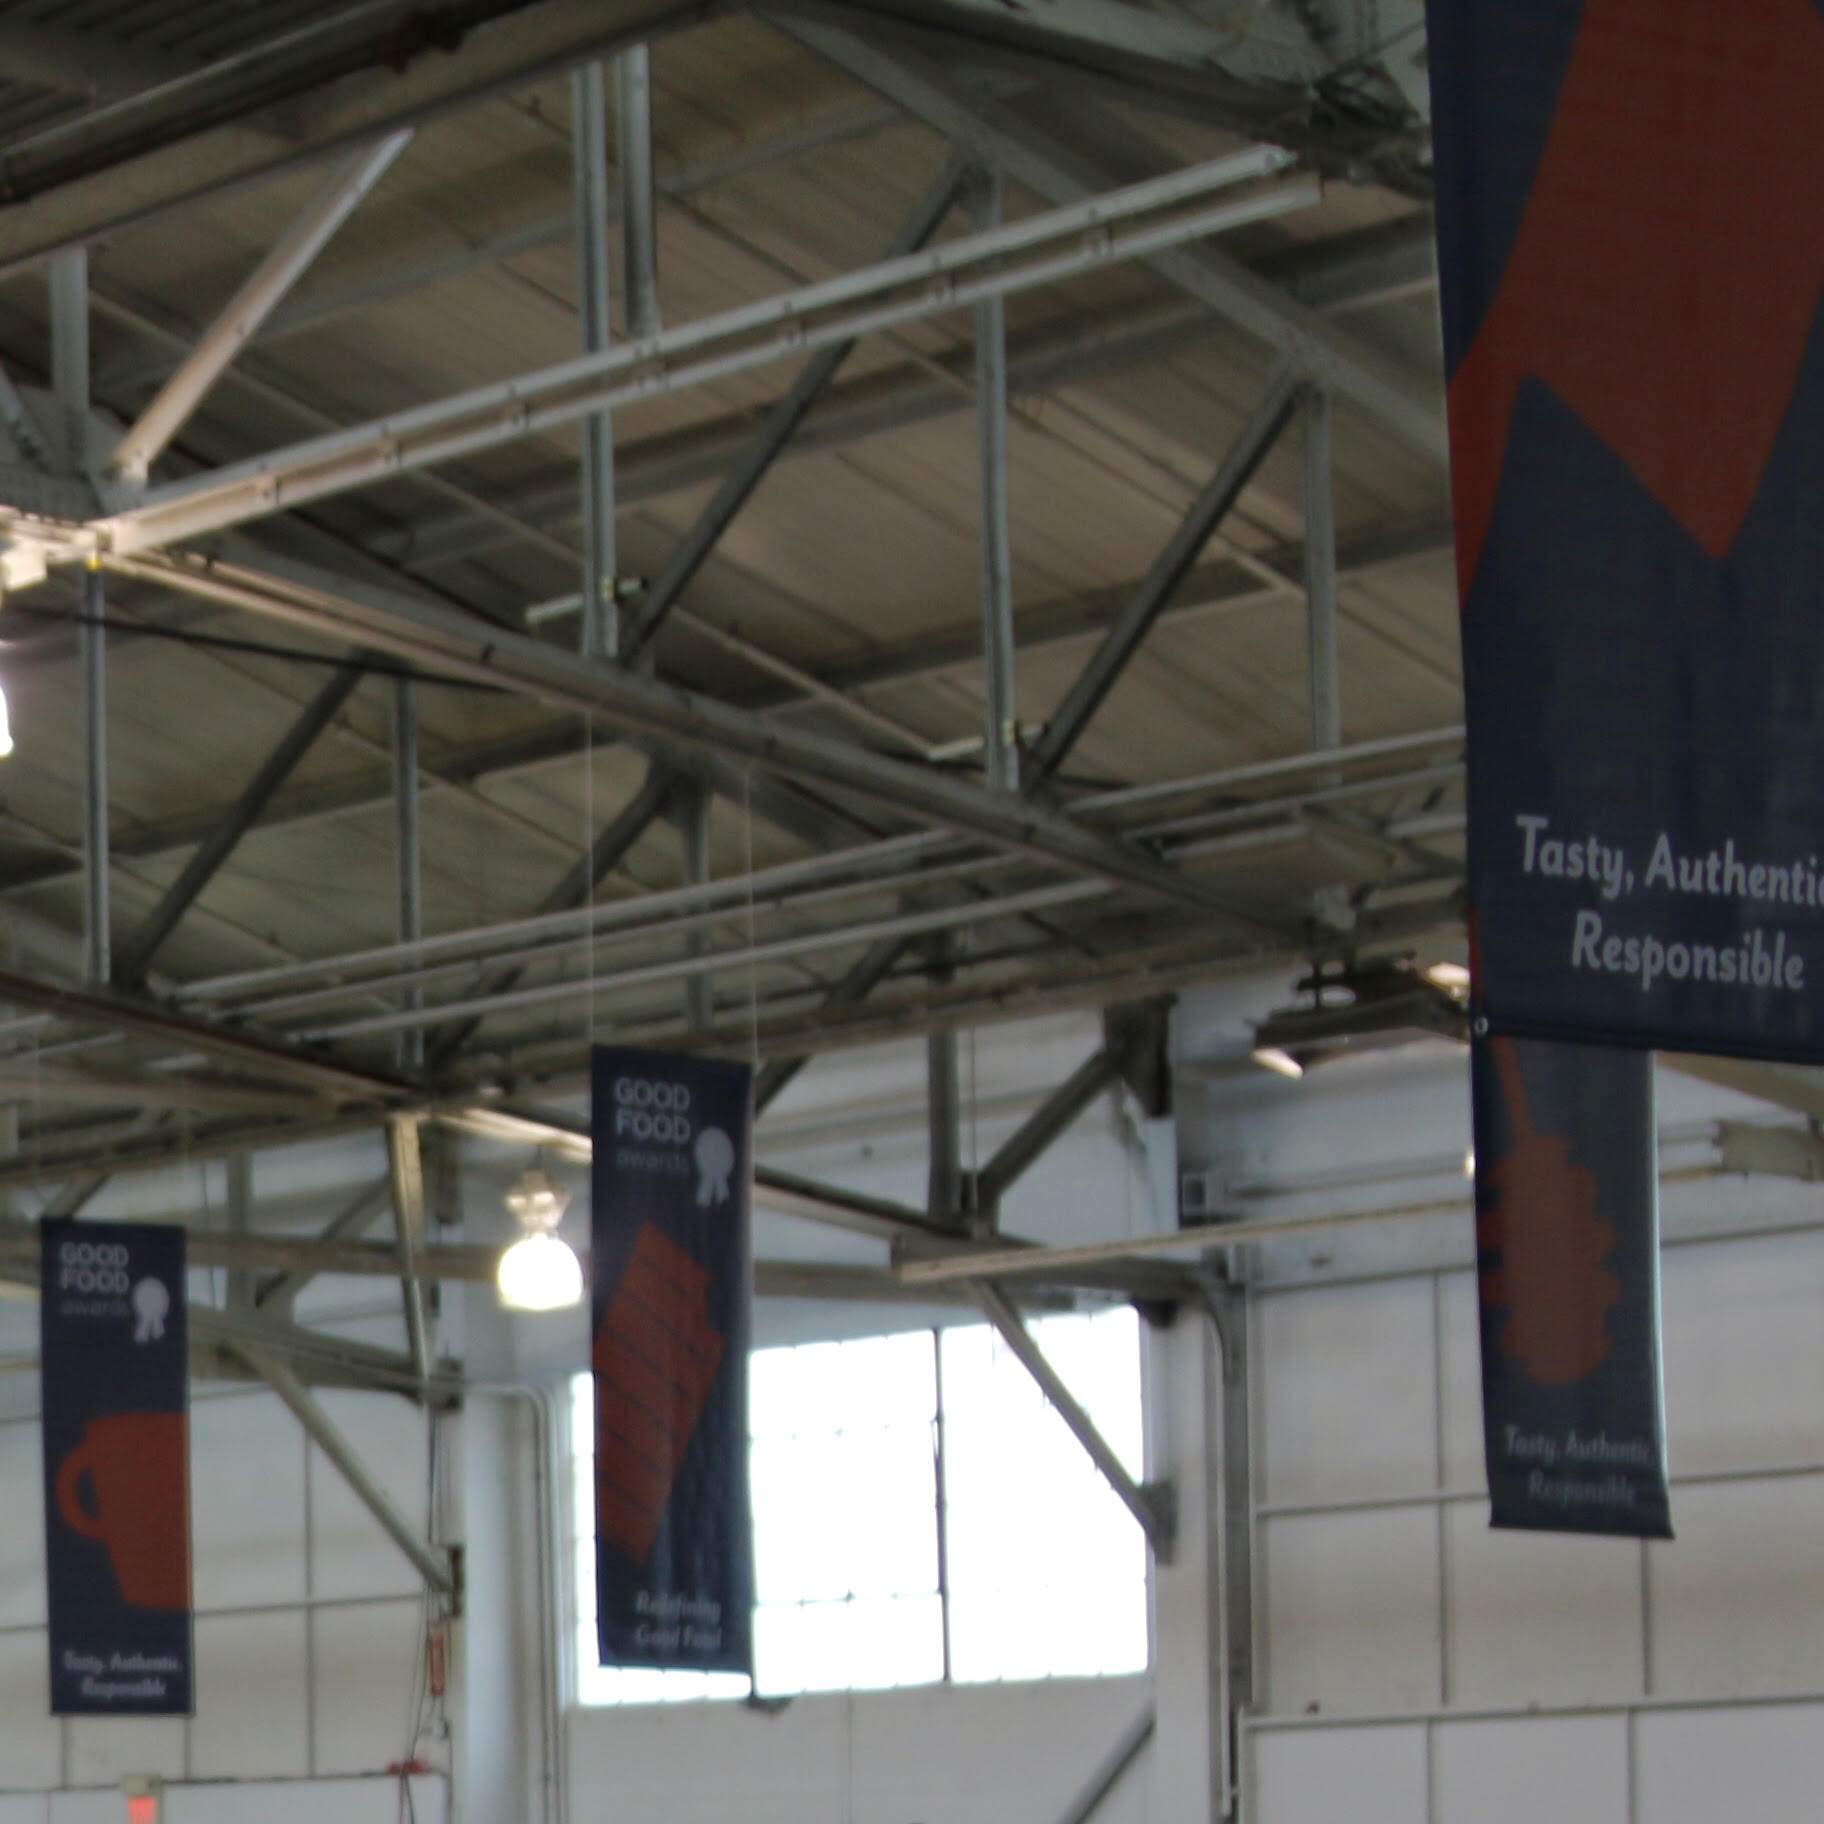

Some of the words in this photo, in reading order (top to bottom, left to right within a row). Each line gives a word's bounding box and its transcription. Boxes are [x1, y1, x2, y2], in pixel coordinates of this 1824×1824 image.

[1516, 815, 1634, 899] Tasty,
[1572, 909, 1804, 991] Responsible
[616, 1077, 690, 1113] GOOD
[616, 1108, 690, 1144] FOOD
[61, 1242, 129, 1267] GOOD
[61, 1267, 129, 1293] FOOD
